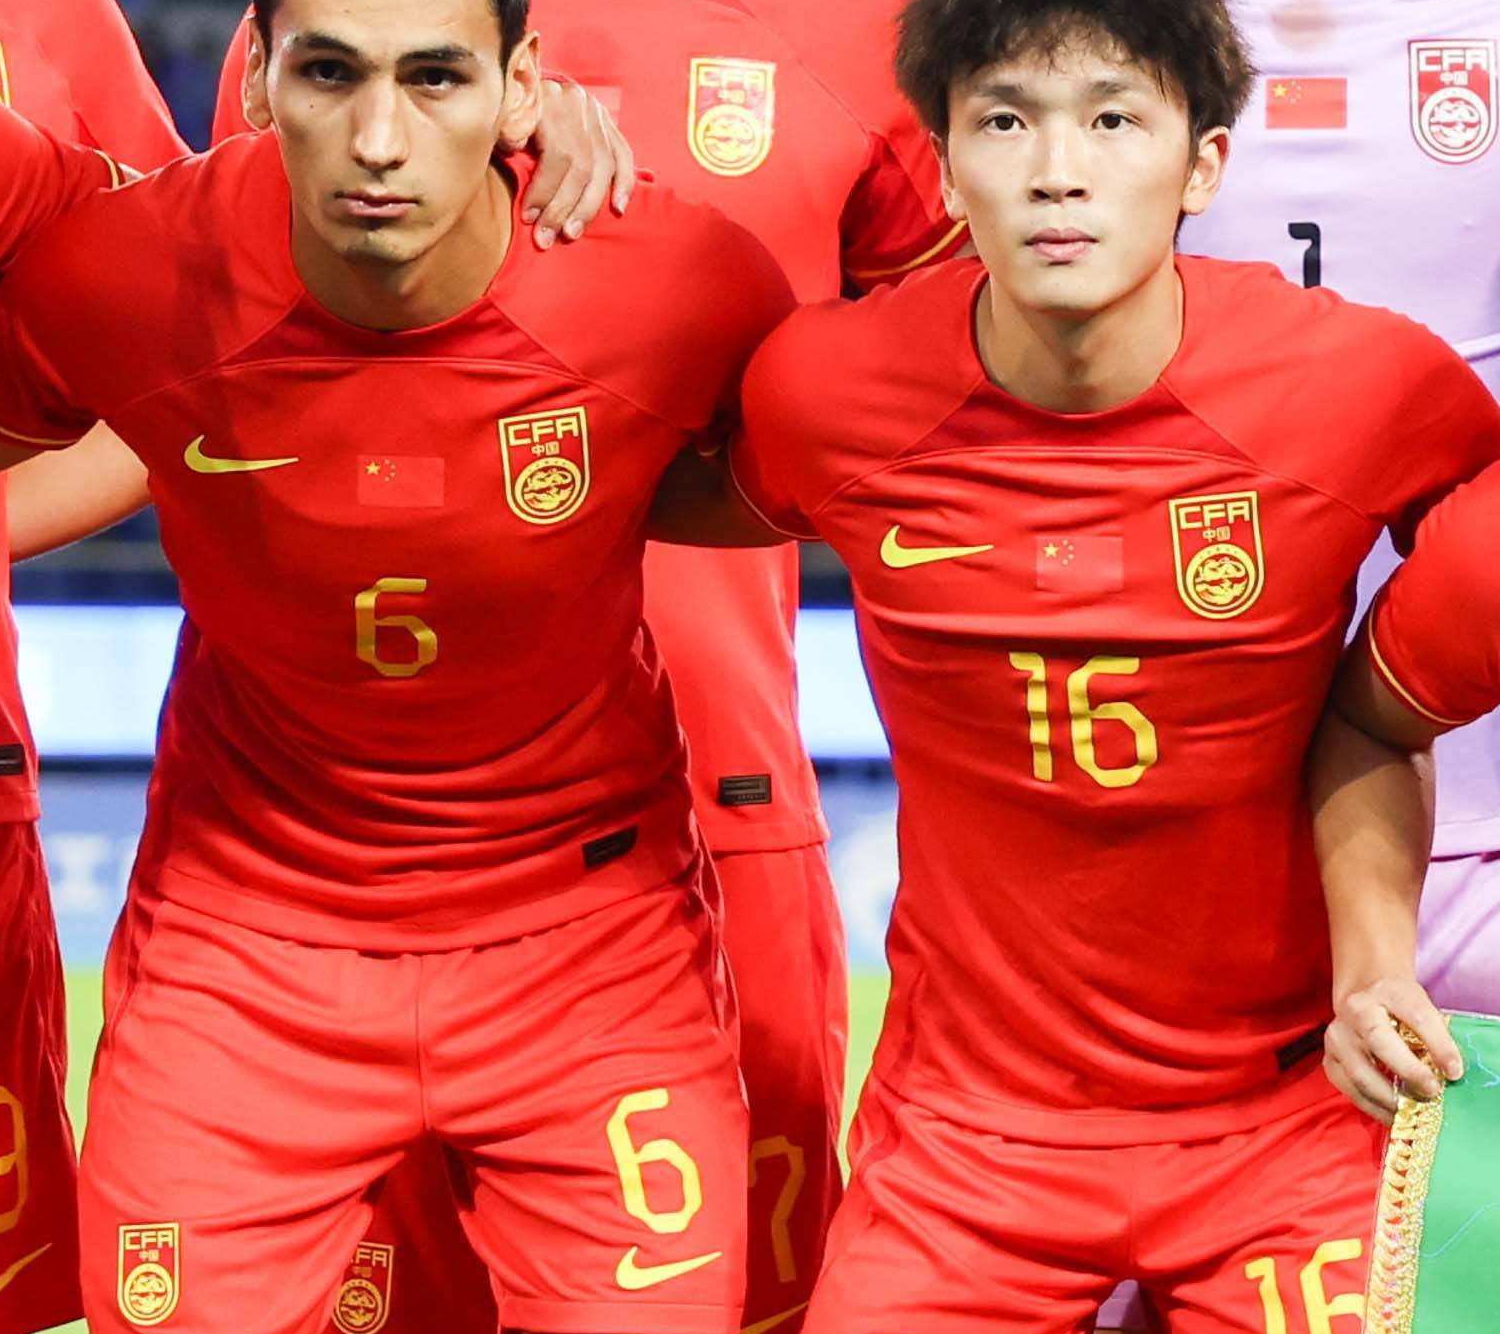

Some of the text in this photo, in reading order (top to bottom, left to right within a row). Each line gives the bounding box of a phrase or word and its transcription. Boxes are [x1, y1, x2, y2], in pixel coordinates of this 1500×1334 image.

[1419, 48, 1488, 72] CFA
[699, 67, 764, 92] CFA
[507, 416, 580, 446] CFA
[1179, 501, 1251, 529] CFA
[355, 577, 438, 678] 6
[1009, 651, 1159, 788] 16
[605, 1087, 703, 1233] 6
[124, 1231, 174, 1250] CFA
[352, 1248, 388, 1268] FA
